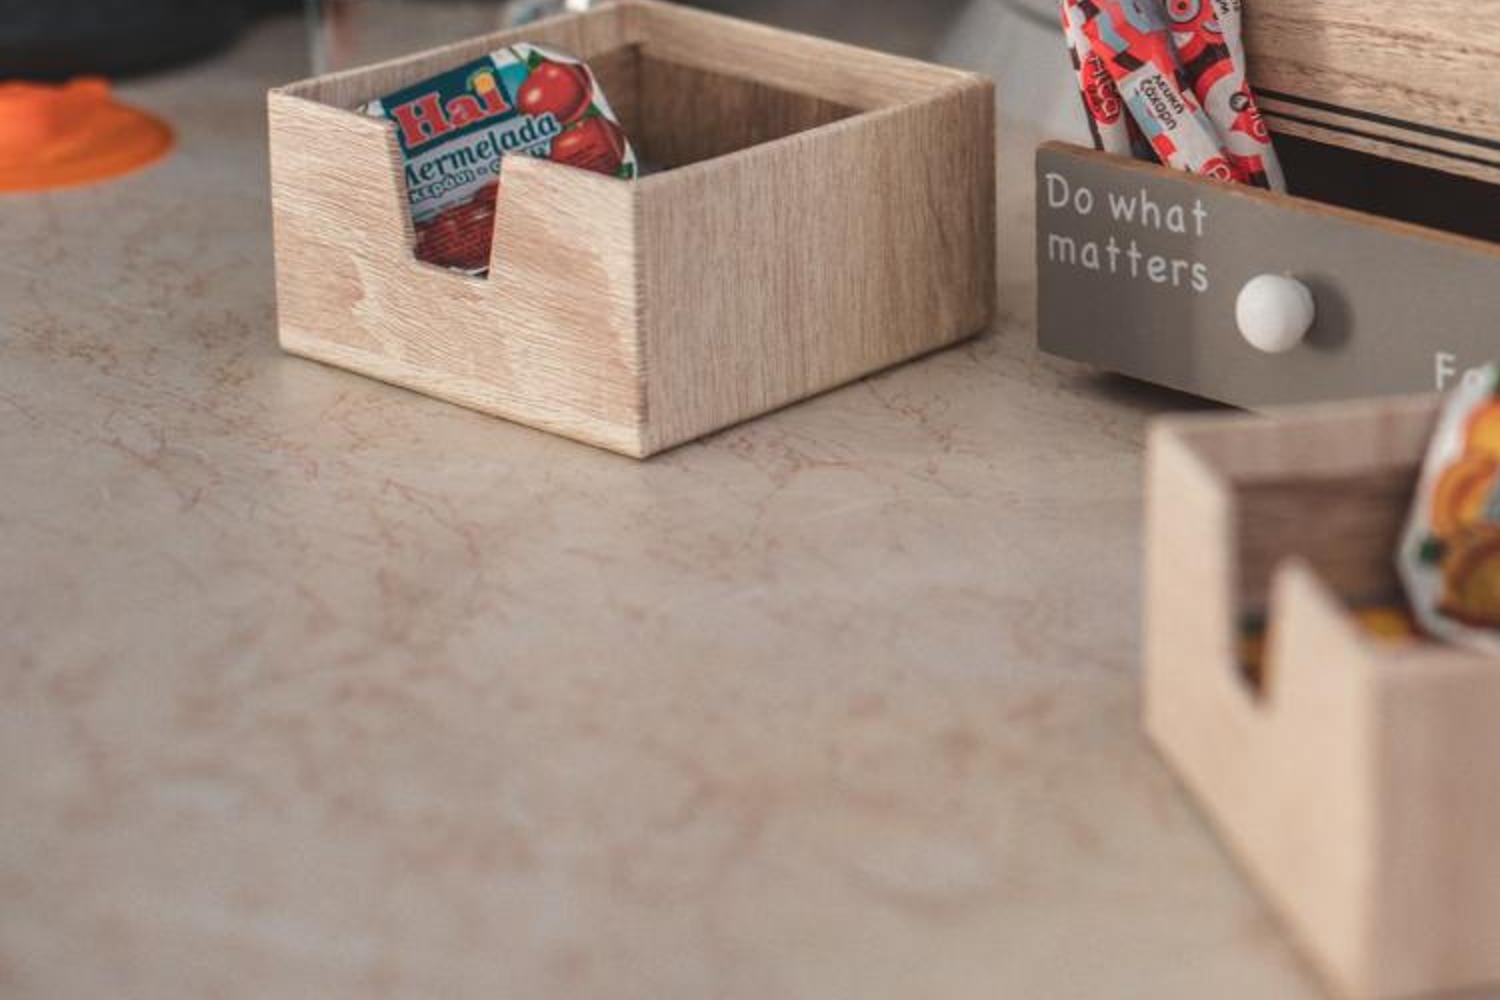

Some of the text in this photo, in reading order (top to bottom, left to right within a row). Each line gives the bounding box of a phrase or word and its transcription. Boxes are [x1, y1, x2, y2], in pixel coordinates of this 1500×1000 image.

[1045, 173, 1209, 237] Do what
[1047, 232, 1210, 293] matters
